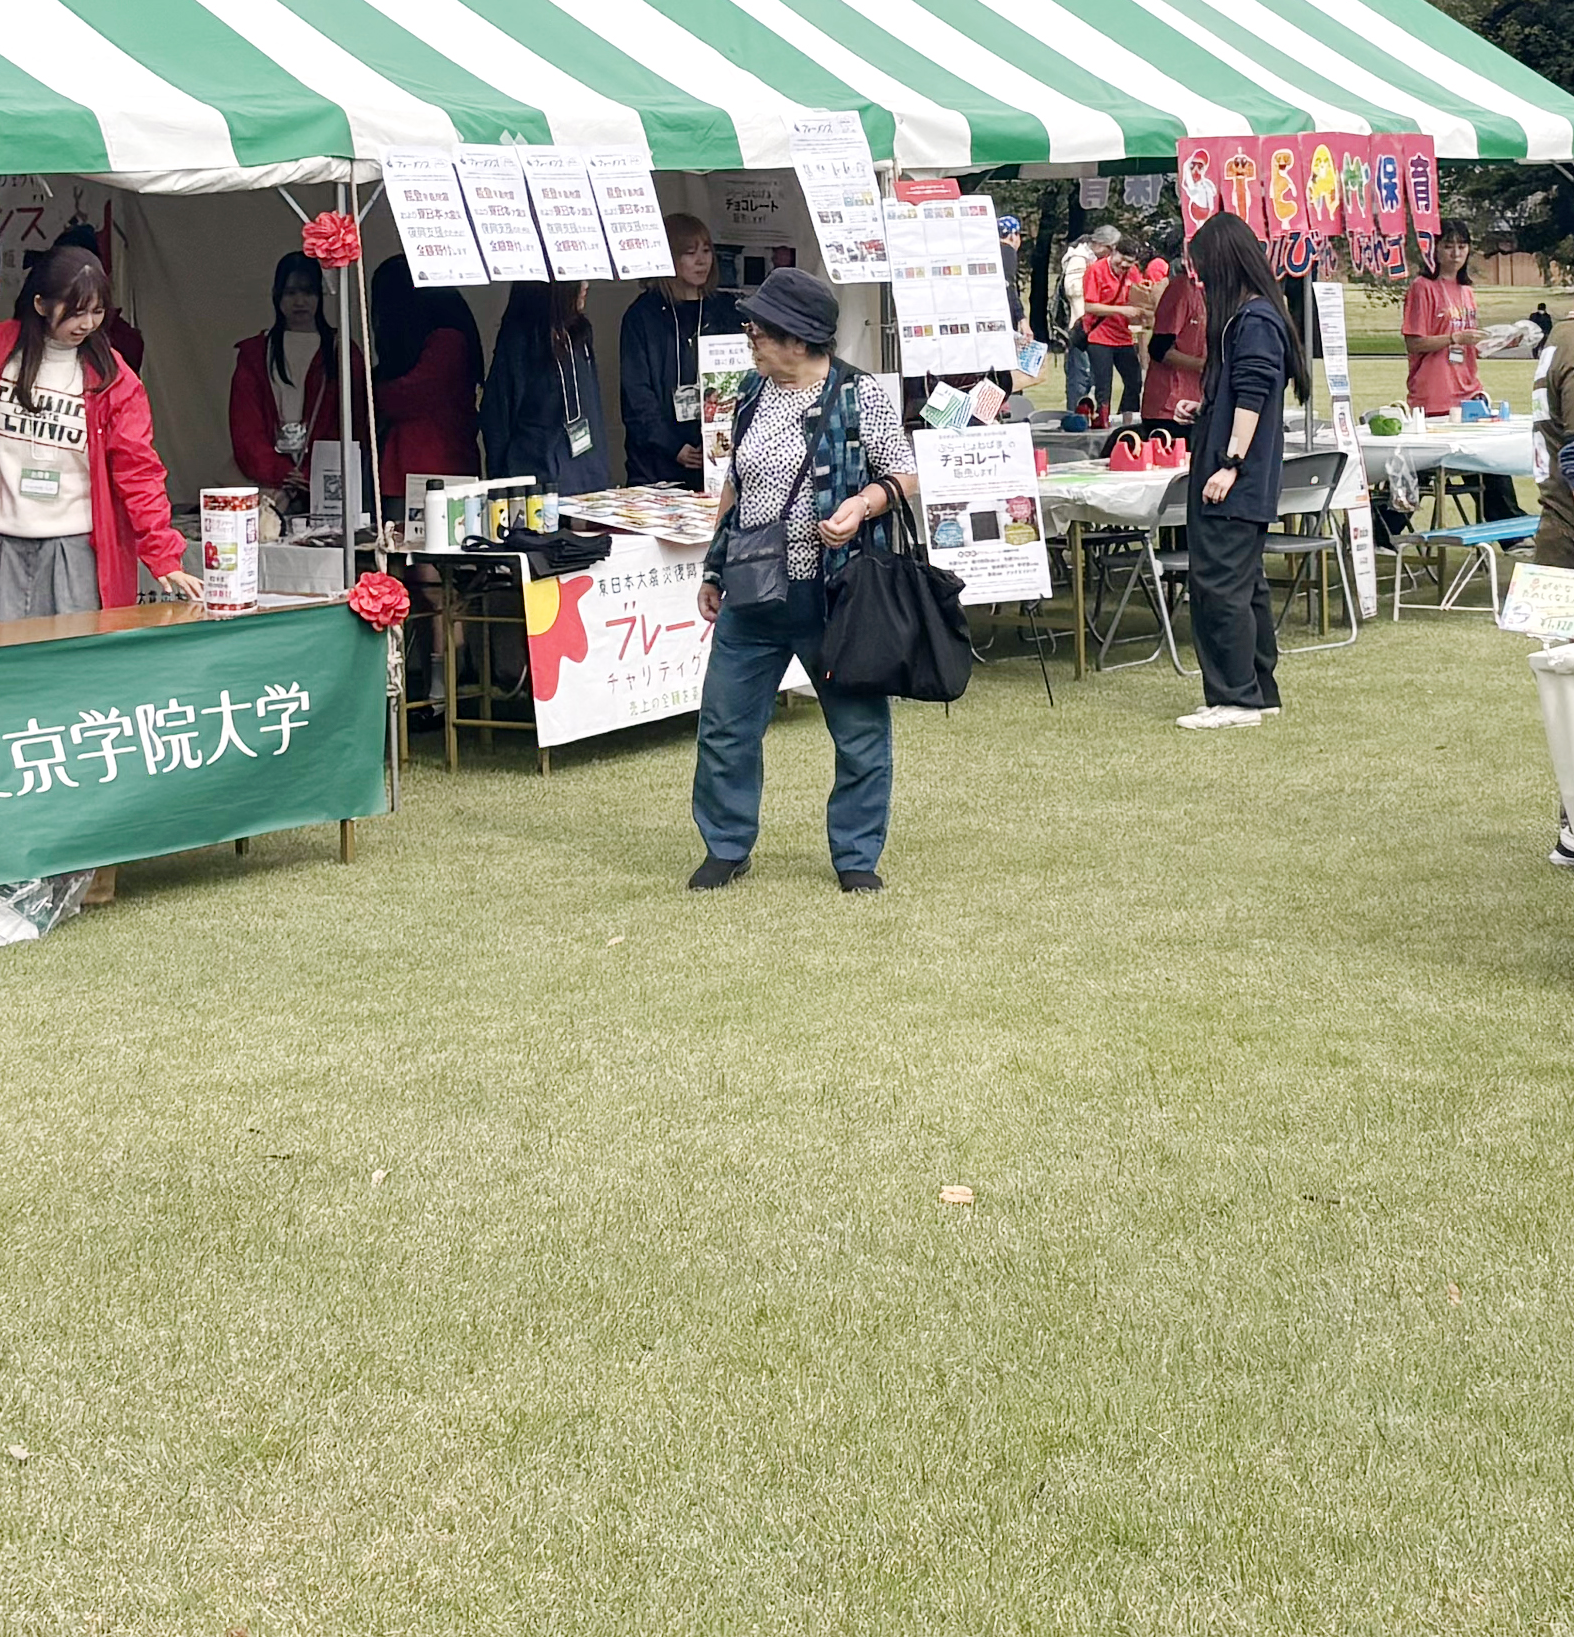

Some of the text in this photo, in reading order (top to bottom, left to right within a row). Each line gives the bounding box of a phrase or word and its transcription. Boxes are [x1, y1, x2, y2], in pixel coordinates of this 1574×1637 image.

[726, 198, 779, 213] チョコレート
[940, 450, 1011, 467] チョコレート
[605, 600, 715, 661] ブレー
